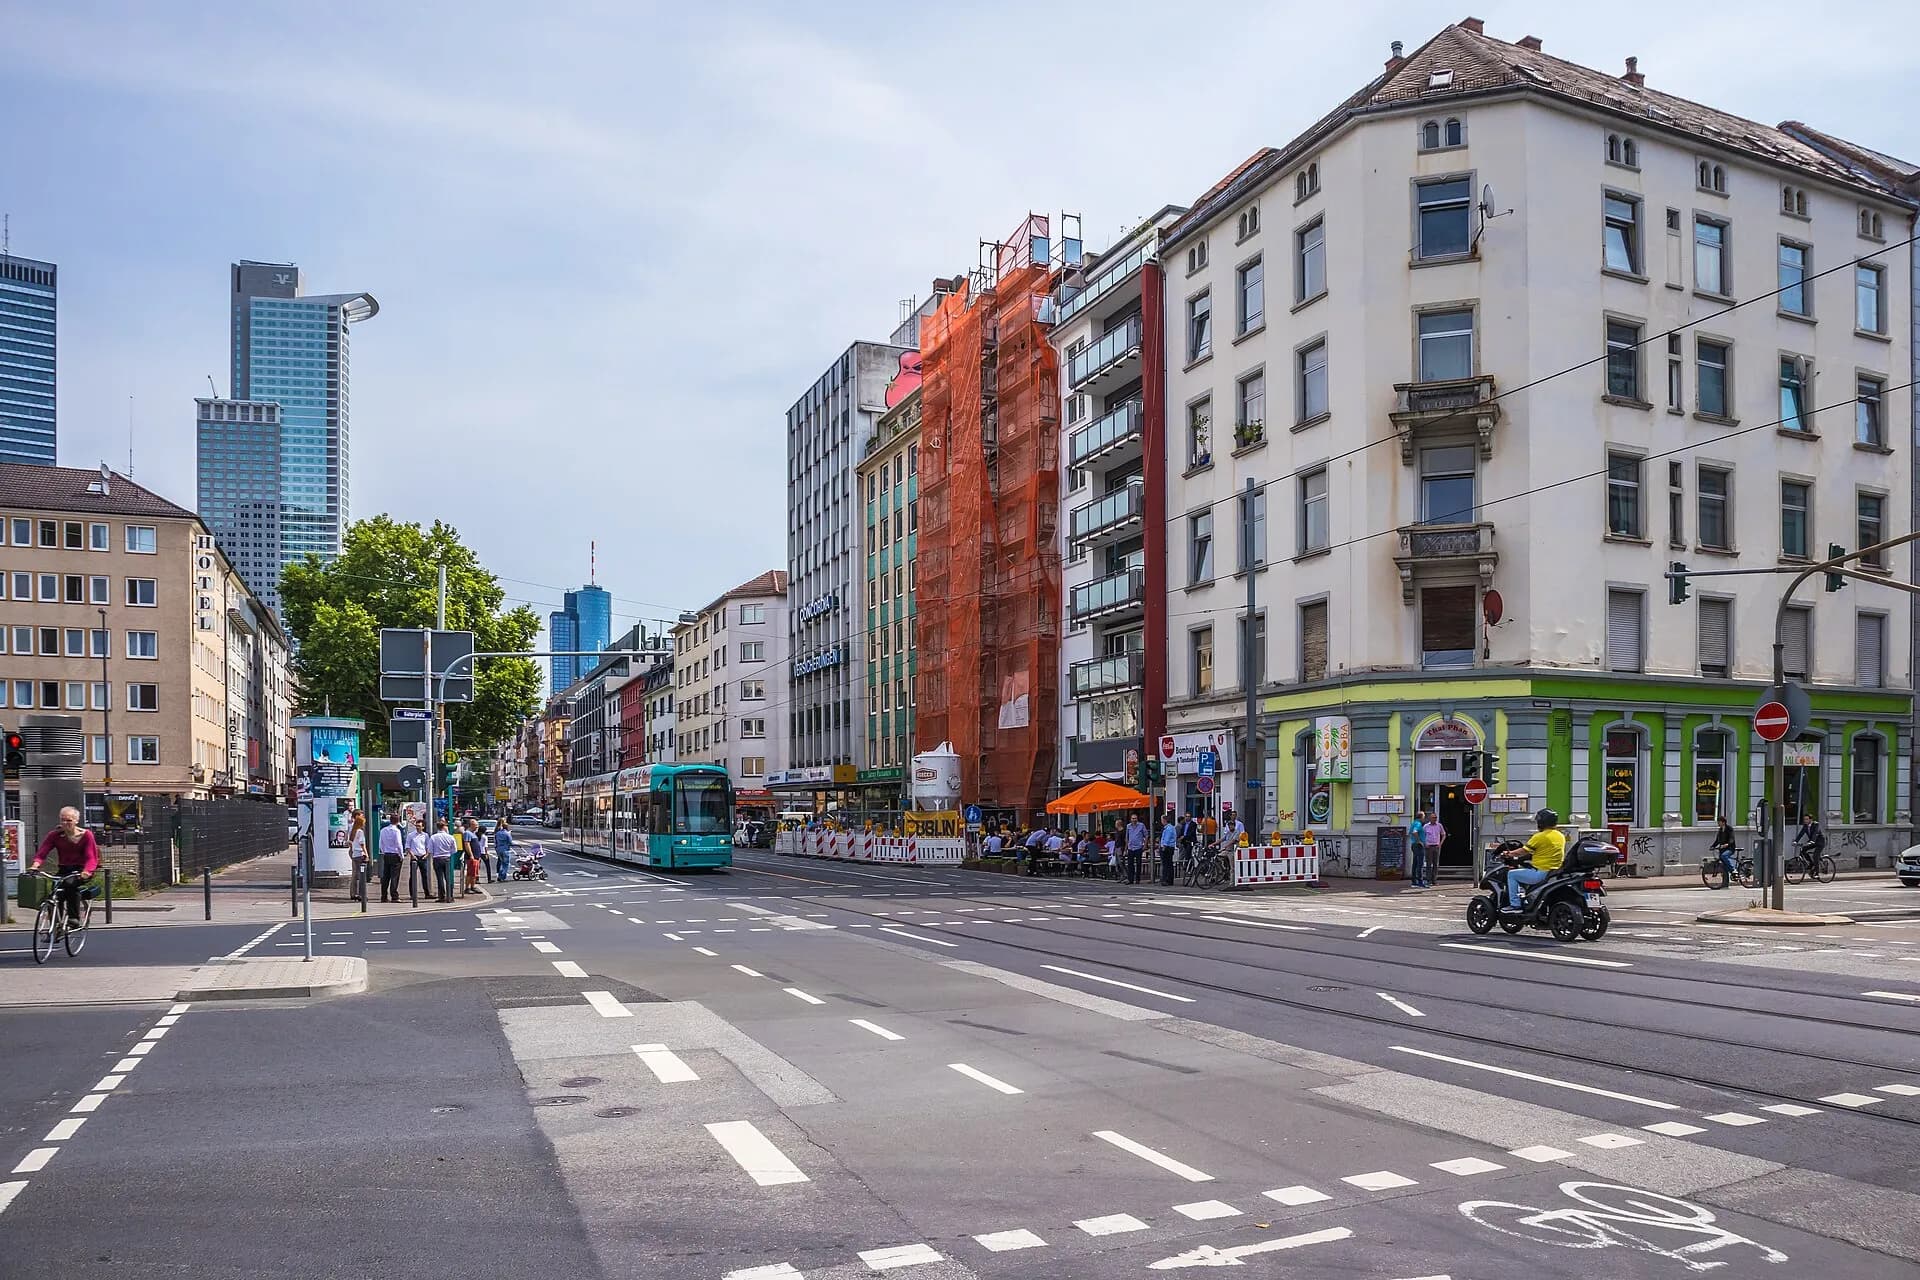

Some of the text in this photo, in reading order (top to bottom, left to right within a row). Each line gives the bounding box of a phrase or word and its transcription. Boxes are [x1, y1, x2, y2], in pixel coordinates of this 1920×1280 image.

[198, 536, 211, 630] HOTEL
[799, 597, 830, 622] CONCORDIA
[793, 648, 838, 678] VERSICHERUNGEN
[228, 717, 237, 759] HOTEL
[313, 728, 338, 740] ALVIN
[1322, 723, 1331, 758] COBA
[1339, 724, 1349, 758] COBA
[1175, 745, 1194, 755] Bombay
[1201, 753, 1208, 763] P
